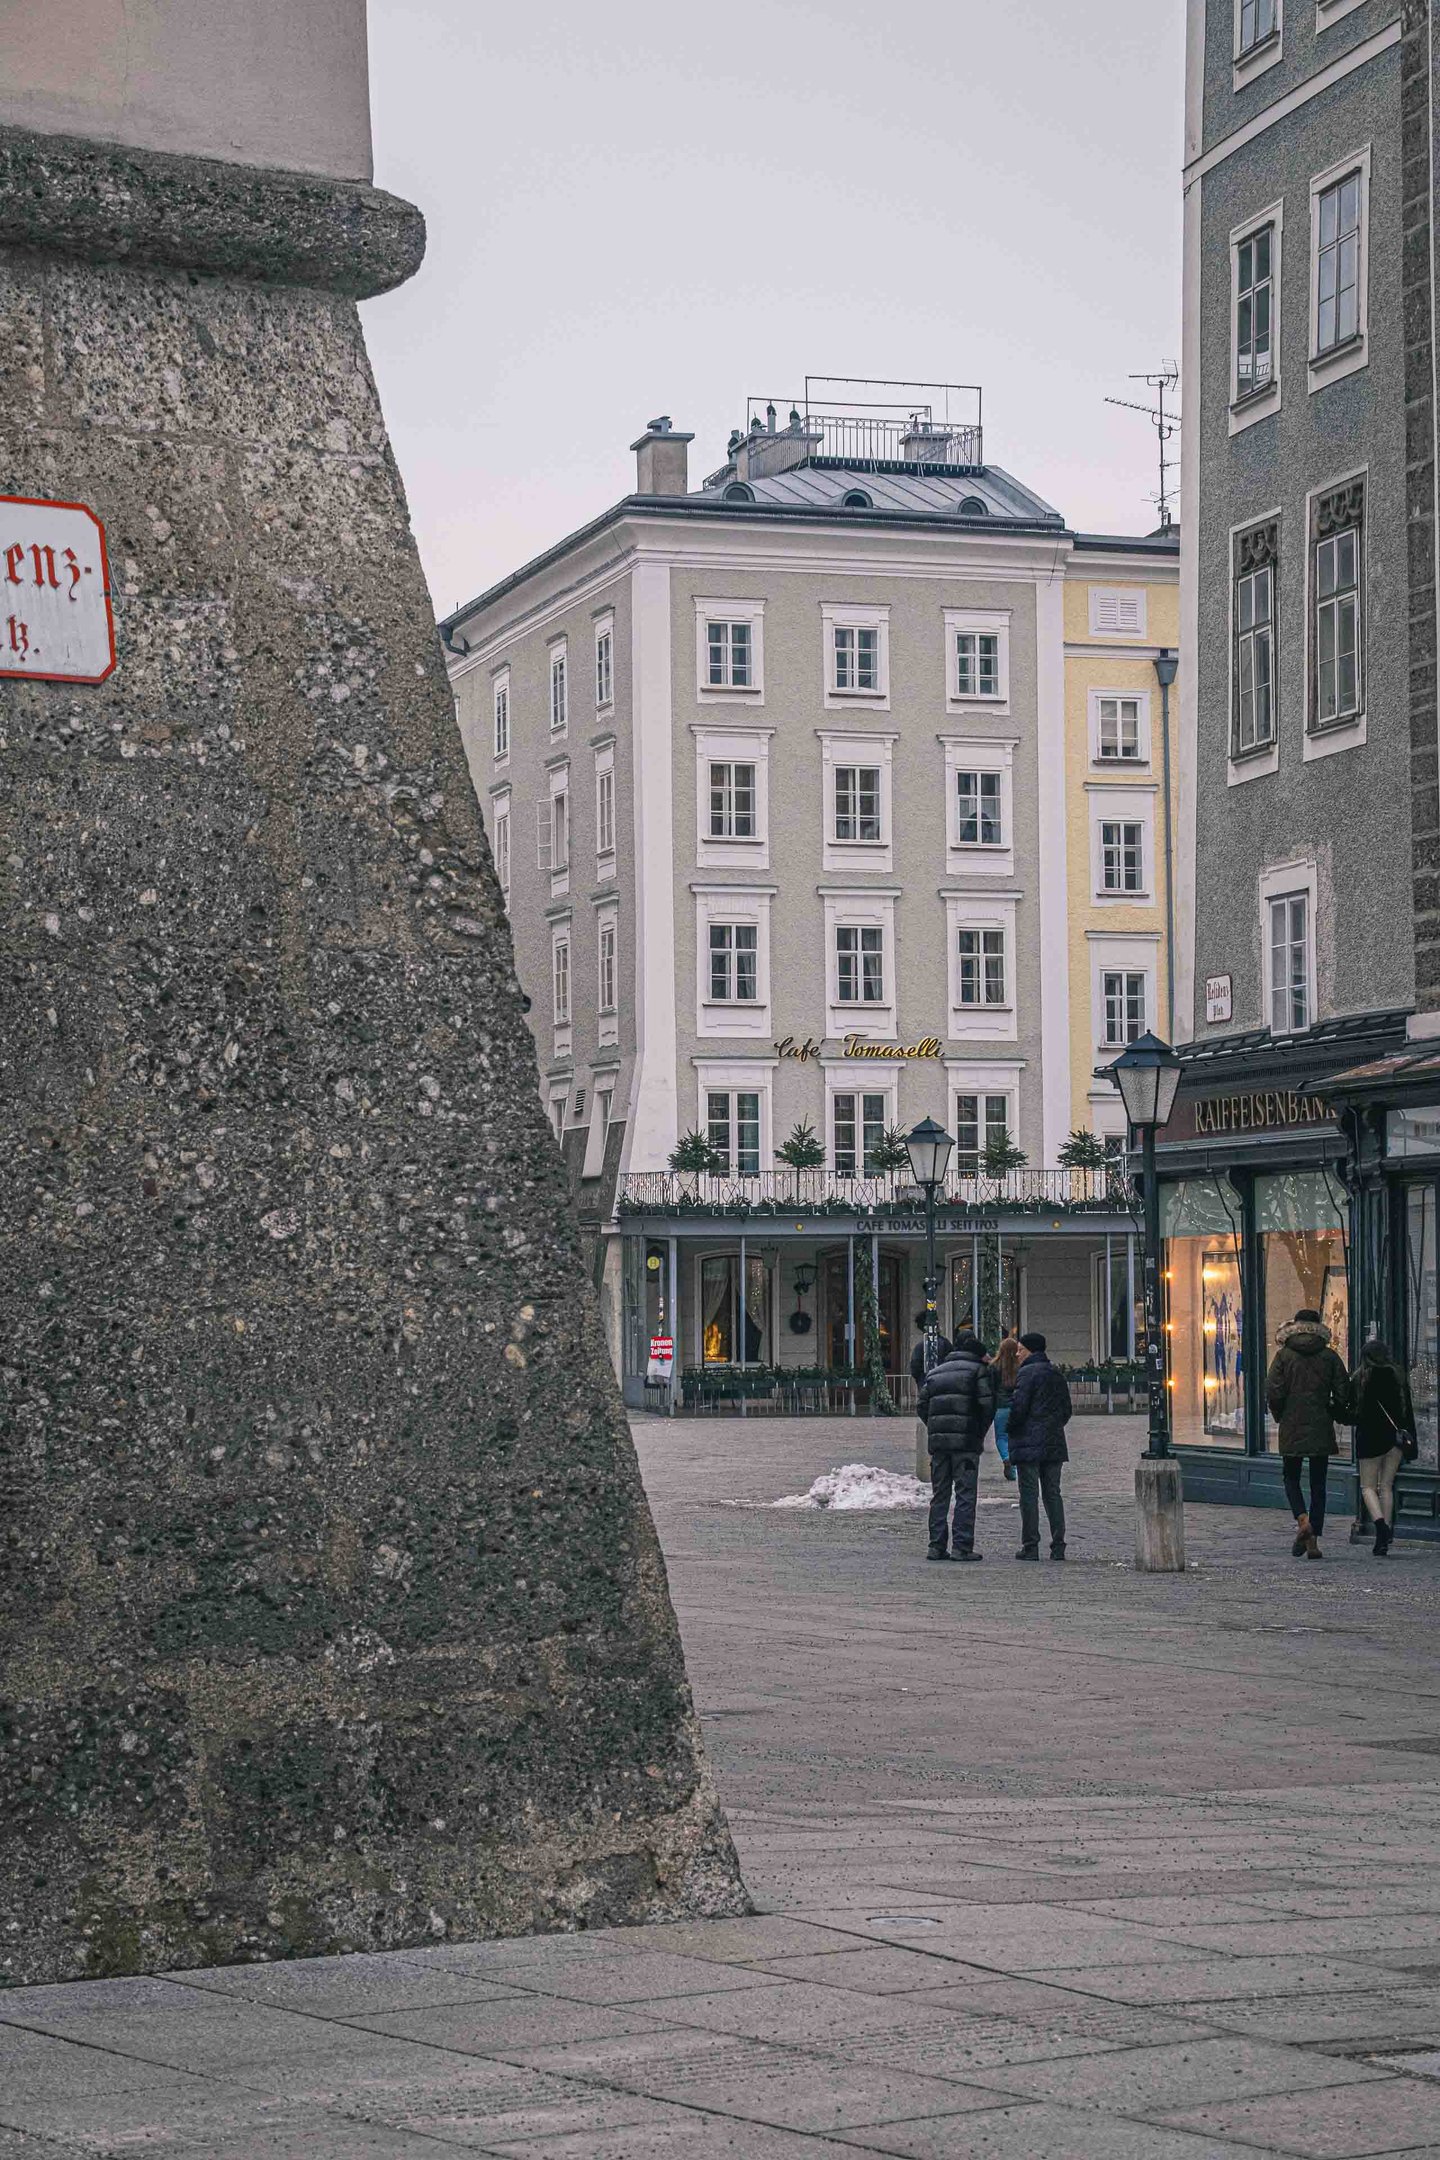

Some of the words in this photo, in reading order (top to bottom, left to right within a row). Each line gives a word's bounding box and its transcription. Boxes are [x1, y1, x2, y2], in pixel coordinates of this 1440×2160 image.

[0, 614, 40, 662] tz.
[774, 1036, 825, 1062] Café
[843, 1032, 945, 1059] Tomaselli
[887, 1220, 947, 1231] TOMASLI
[951, 1220, 972, 1231] SEIT
[650, 1338, 673, 1347] Kronen
